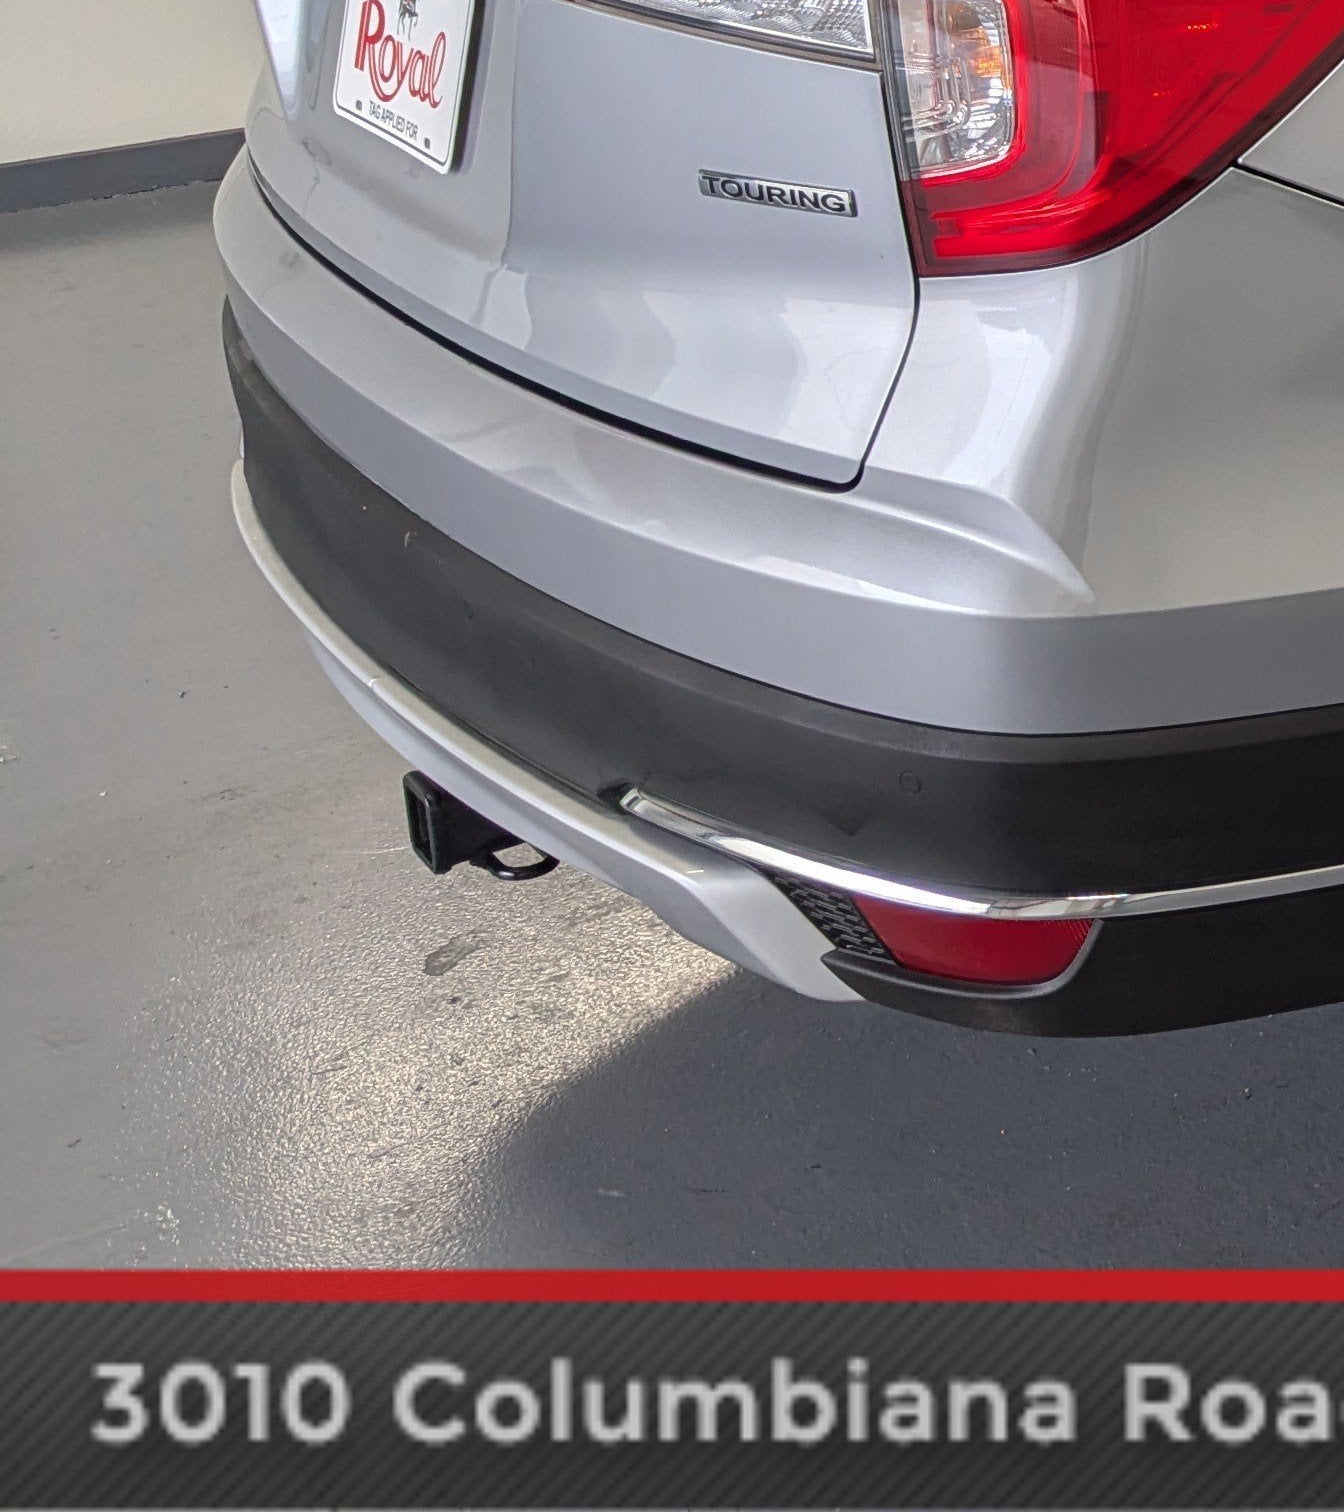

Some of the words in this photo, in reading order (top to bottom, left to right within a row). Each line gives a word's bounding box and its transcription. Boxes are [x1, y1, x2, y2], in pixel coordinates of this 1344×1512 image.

[369, 100, 381, 120] TAG
[380, 107, 406, 133] APPLIED
[405, 120, 419, 141] FOR
[701, 175, 846, 213] TOURING
